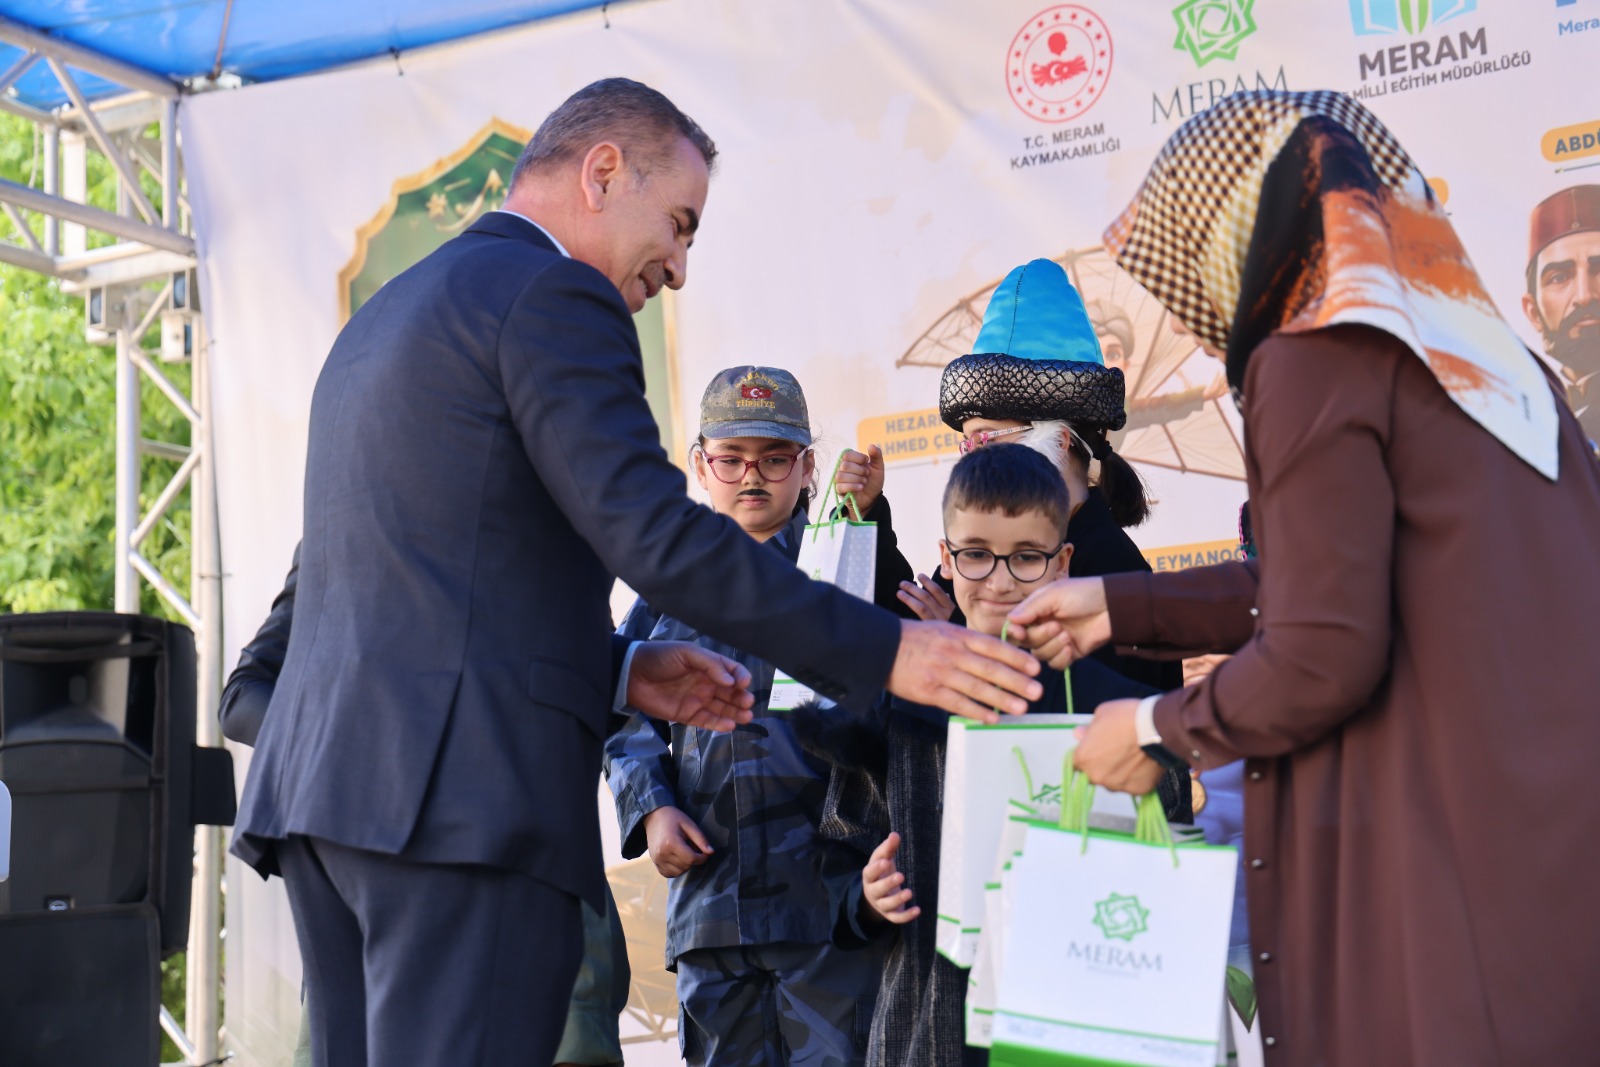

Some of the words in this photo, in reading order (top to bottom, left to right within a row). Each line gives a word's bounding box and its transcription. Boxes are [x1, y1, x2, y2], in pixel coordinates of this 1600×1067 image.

[1358, 26, 1488, 82] MERAM
[1352, 80, 1388, 101] MİLLİ
[1391, 71, 1438, 94] EĞİTİM
[1441, 50, 1532, 82] MÜDÜRLÜĞÜ
[1023, 134, 1049, 150] T.C.
[1052, 122, 1105, 145] MERAM
[1010, 137, 1121, 171] KAYMAKAMLIĞI
[735, 399, 776, 409] TÜRKİYE
[1066, 939, 1162, 972] MERAM
